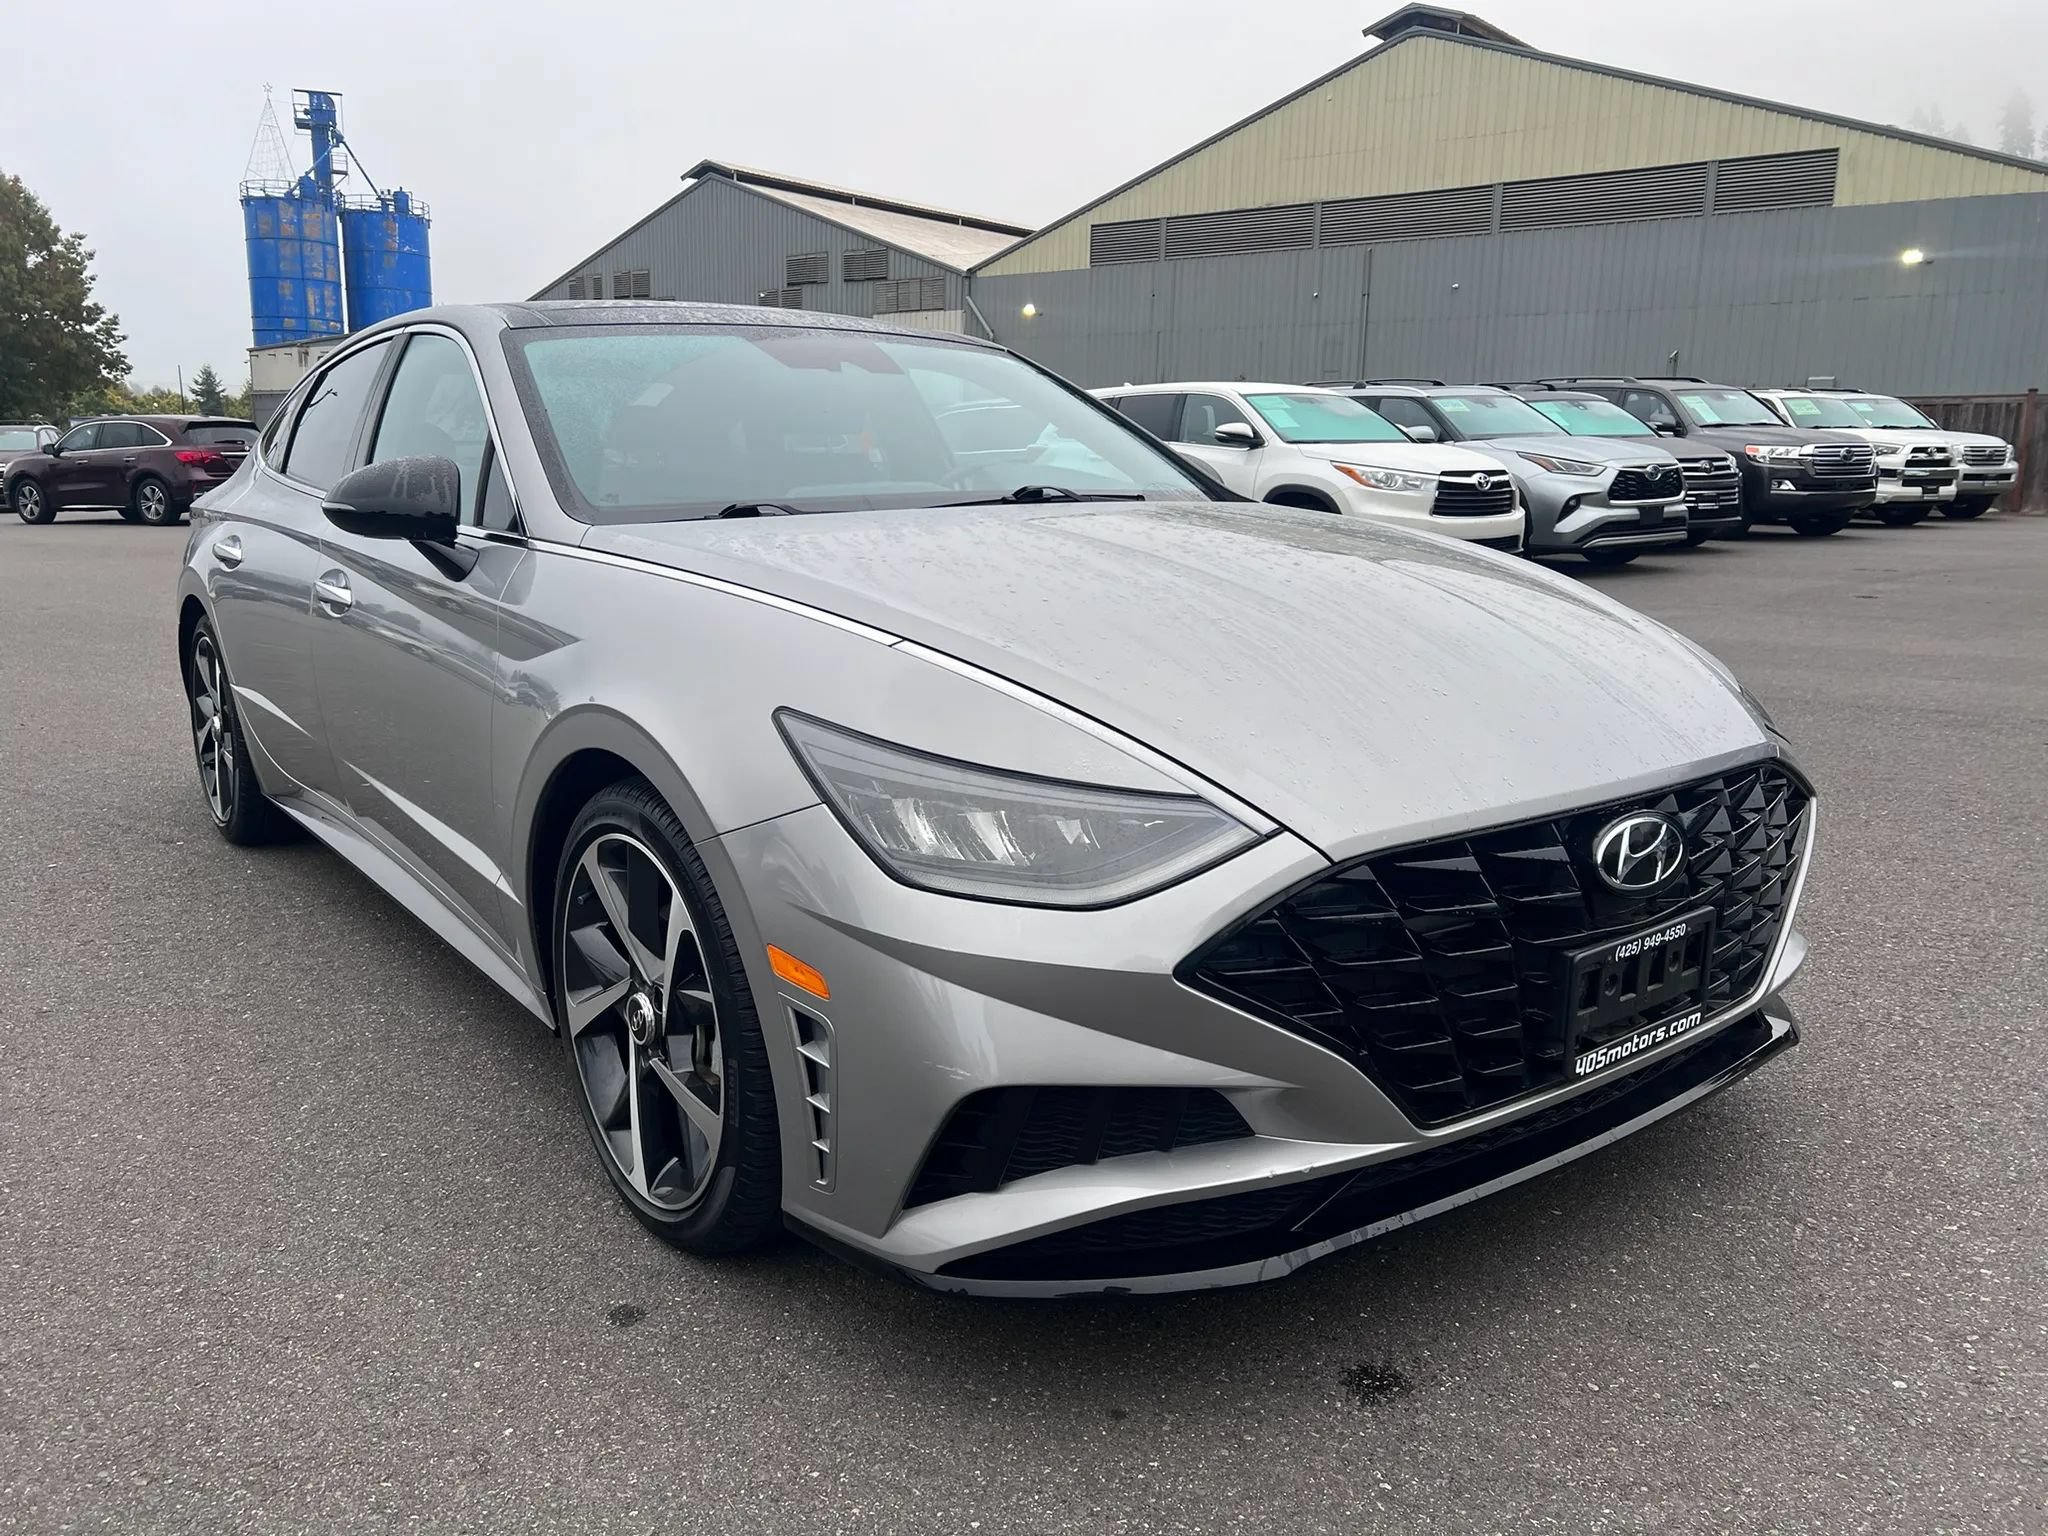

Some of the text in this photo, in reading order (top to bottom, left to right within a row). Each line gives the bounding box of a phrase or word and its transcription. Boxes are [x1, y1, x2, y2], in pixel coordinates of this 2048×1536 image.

[1615, 923, 1687, 962] (425) 949-4550
[1575, 1012, 1702, 1076] 405motors.com
